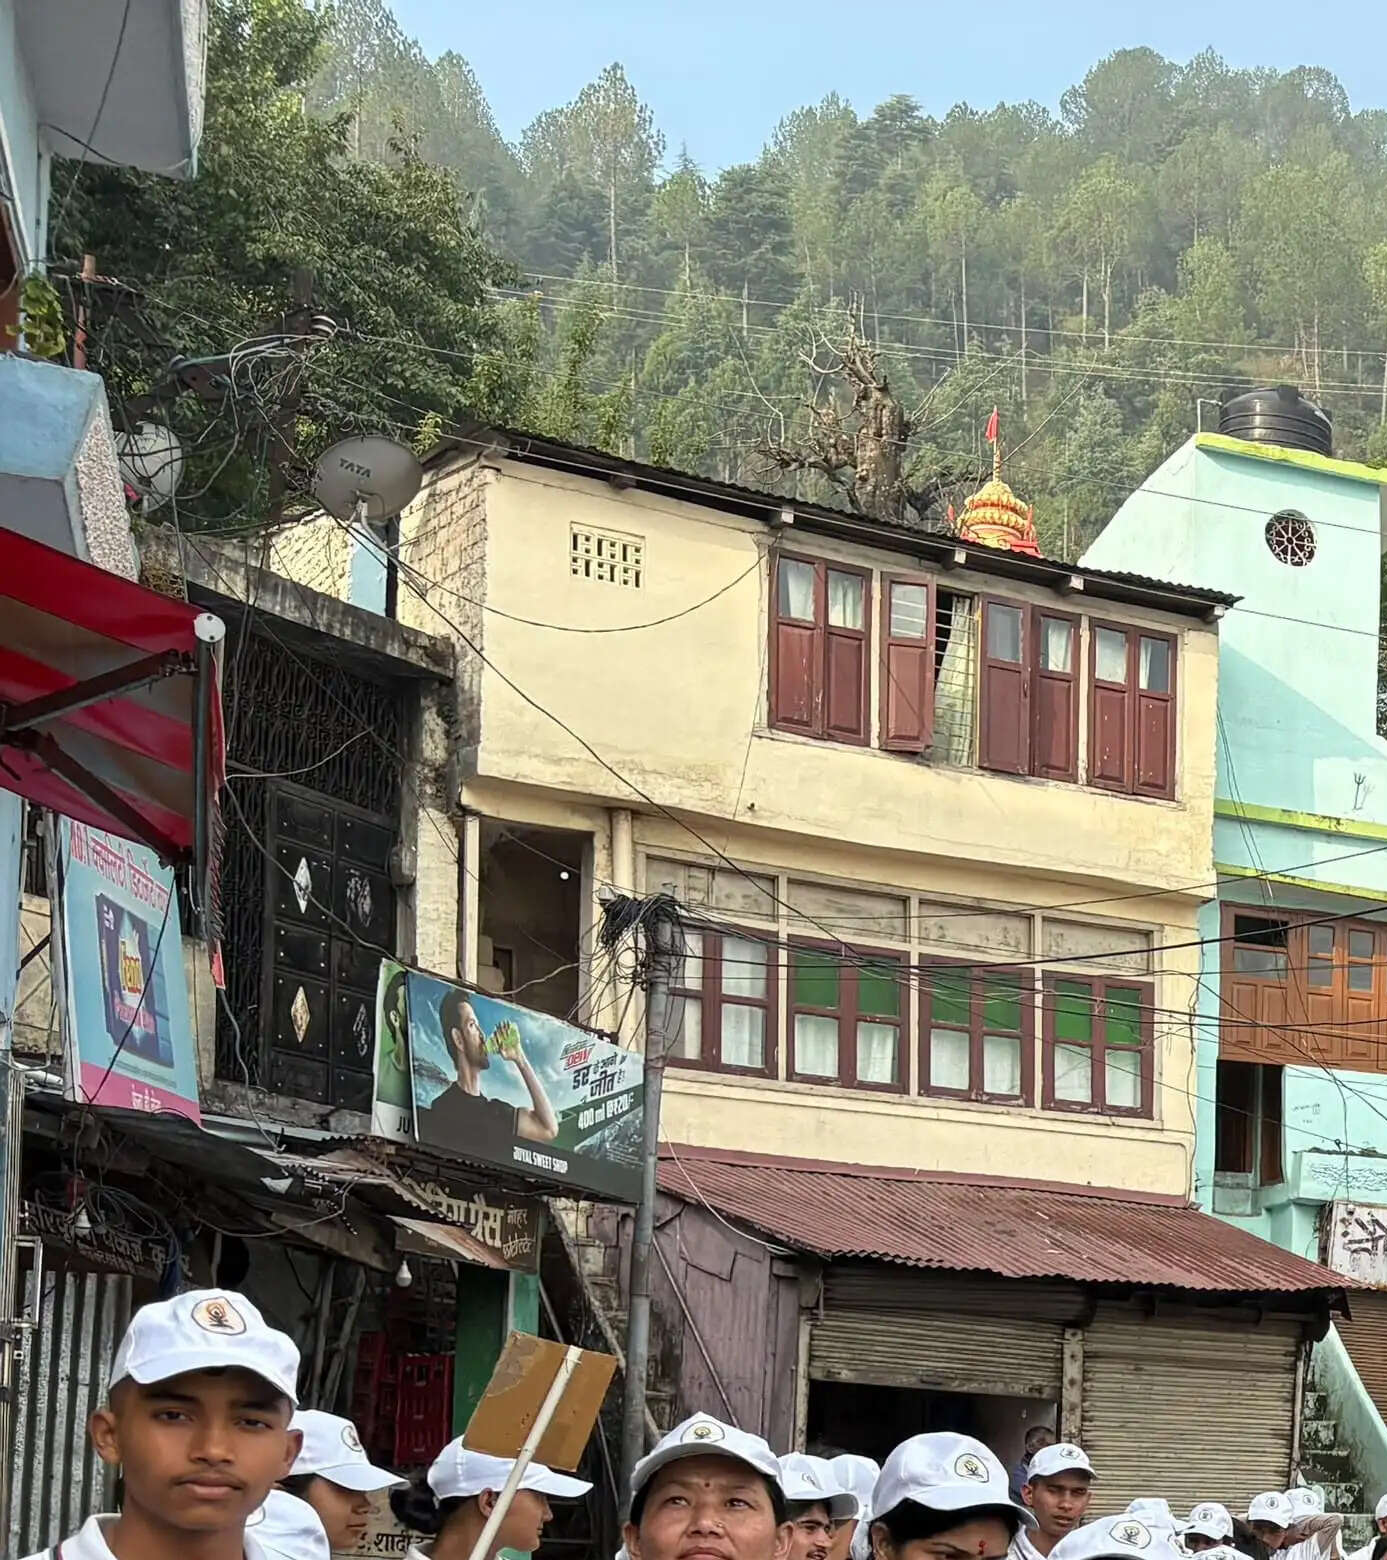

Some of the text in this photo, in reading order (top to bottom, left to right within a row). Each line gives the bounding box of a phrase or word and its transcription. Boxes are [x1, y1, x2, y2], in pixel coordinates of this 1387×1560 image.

[340, 457, 371, 478] TATA
[397, 1115, 412, 1134] JU
[578, 1107, 594, 1130] 400
[594, 1104, 606, 1123] ml
[532, 1150, 553, 1170] SWEET
[552, 1157, 569, 1175] SHOP
